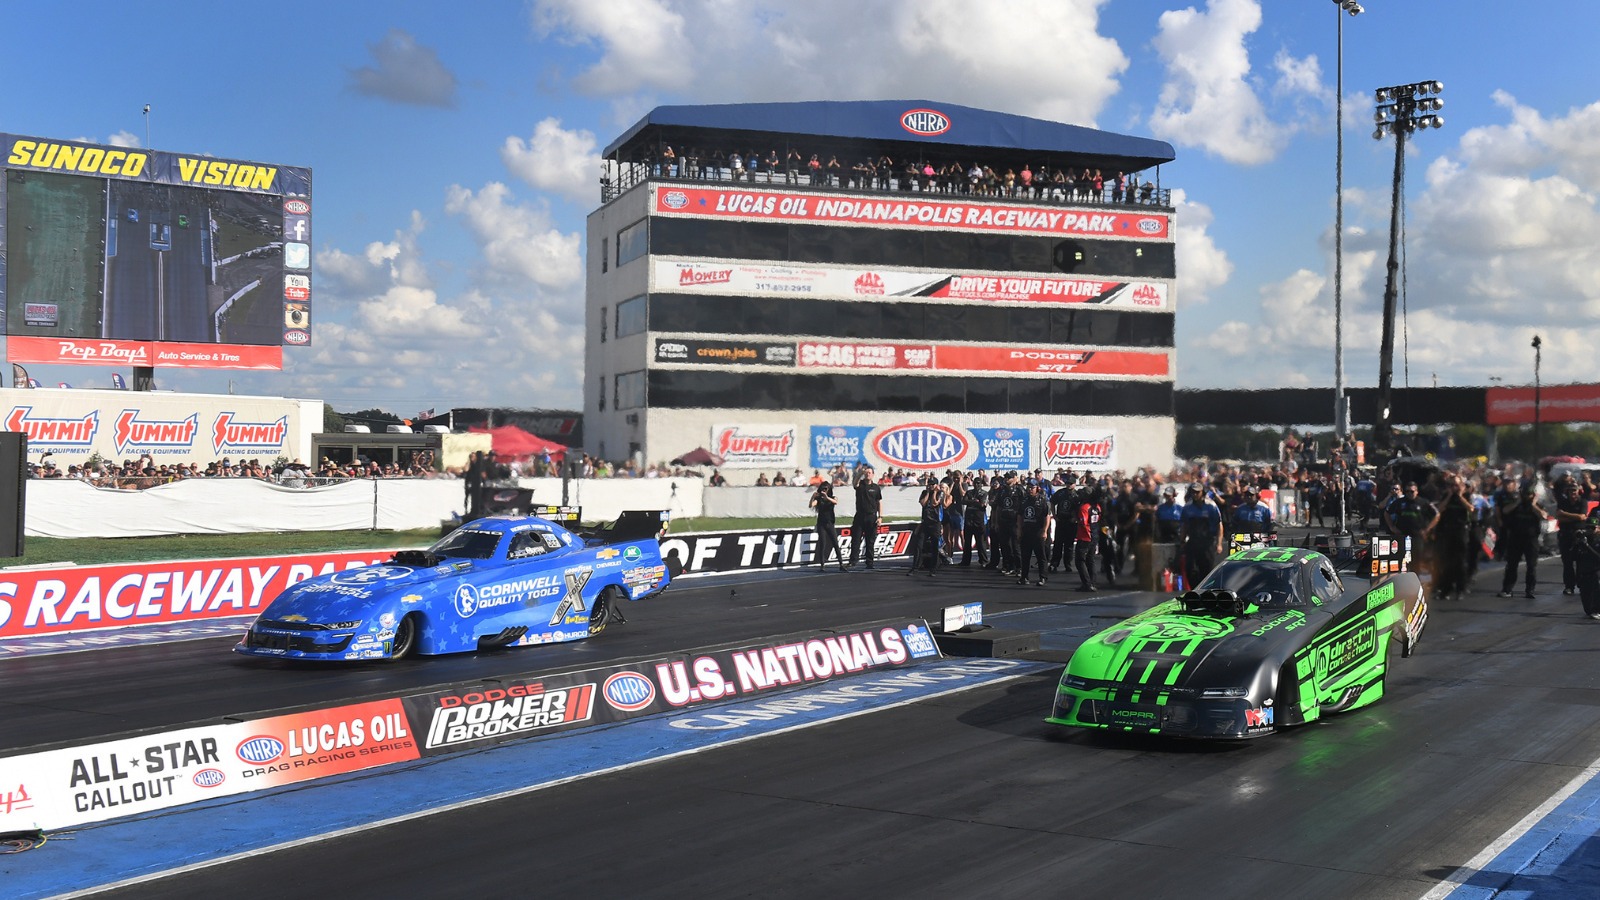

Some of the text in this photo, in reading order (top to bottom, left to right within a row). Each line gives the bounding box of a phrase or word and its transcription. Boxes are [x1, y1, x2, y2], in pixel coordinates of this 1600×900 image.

[907, 114, 945, 132] NHRA
[8, 140, 277, 189] SUNOCO VISION
[286, 202, 308, 211] NHRA
[716, 194, 1116, 233] LUCAS OIL INDIANAPOLIS RACEWAY PARK
[1140, 221, 1160, 231] NHRA
[680, 268, 732, 282] MOWERY
[950, 277, 1102, 297] DRIVE YOUR FUTURE
[286, 332, 308, 342] NHRA
[58, 341, 147, 362] Pep Boys
[158, 351, 240, 362] Auto Service & Tires
[801, 345, 855, 366] SCAG
[1010, 352, 1083, 360] DODGE
[1036, 364, 1078, 373] SRT
[117, 413, 195, 449] SUMMIT
[214, 415, 283, 449] SUMMIT
[816, 435, 858, 445] CAMPING
[719, 428, 790, 456] SUMMIT
[817, 445, 859, 456] WORLD
[889, 430, 957, 463] NHRA
[983, 439, 1023, 447] CAMPING
[984, 448, 1024, 457] WORLD
[1047, 434, 1109, 460] SUMMIT
[659, 533, 818, 570] OF THE
[24, 564, 282, 627] RACEWAY
[480, 576, 559, 598] CORNWELL
[479, 587, 560, 609] QUALITY TOOLS
[964, 605, 981, 614] CAMPING
[965, 613, 982, 625] WORLD
[1252, 612, 1297, 636] DODGE
[1285, 618, 1307, 631] SRT
[905, 632, 929, 643] CAMPING
[908, 641, 932, 653] WORLD
[656, 627, 907, 707] U.S. NATIONALS
[440, 683, 546, 708] DODGE
[610, 678, 650, 705] NHRA
[668, 658, 1021, 731] CAMPING WORLD
[433, 690, 567, 745] POWER
[1112, 710, 1154, 719] MOPAR
[288, 712, 407, 757] LUCAS OIL
[448, 709, 566, 742] BROKERS
[241, 740, 283, 761] NHRA
[242, 741, 413, 778] DRAG RACING SERIES
[70, 738, 220, 788] ALL STAR
[195, 771, 224, 786] NHRA
[74, 776, 177, 813] CALLOUT
